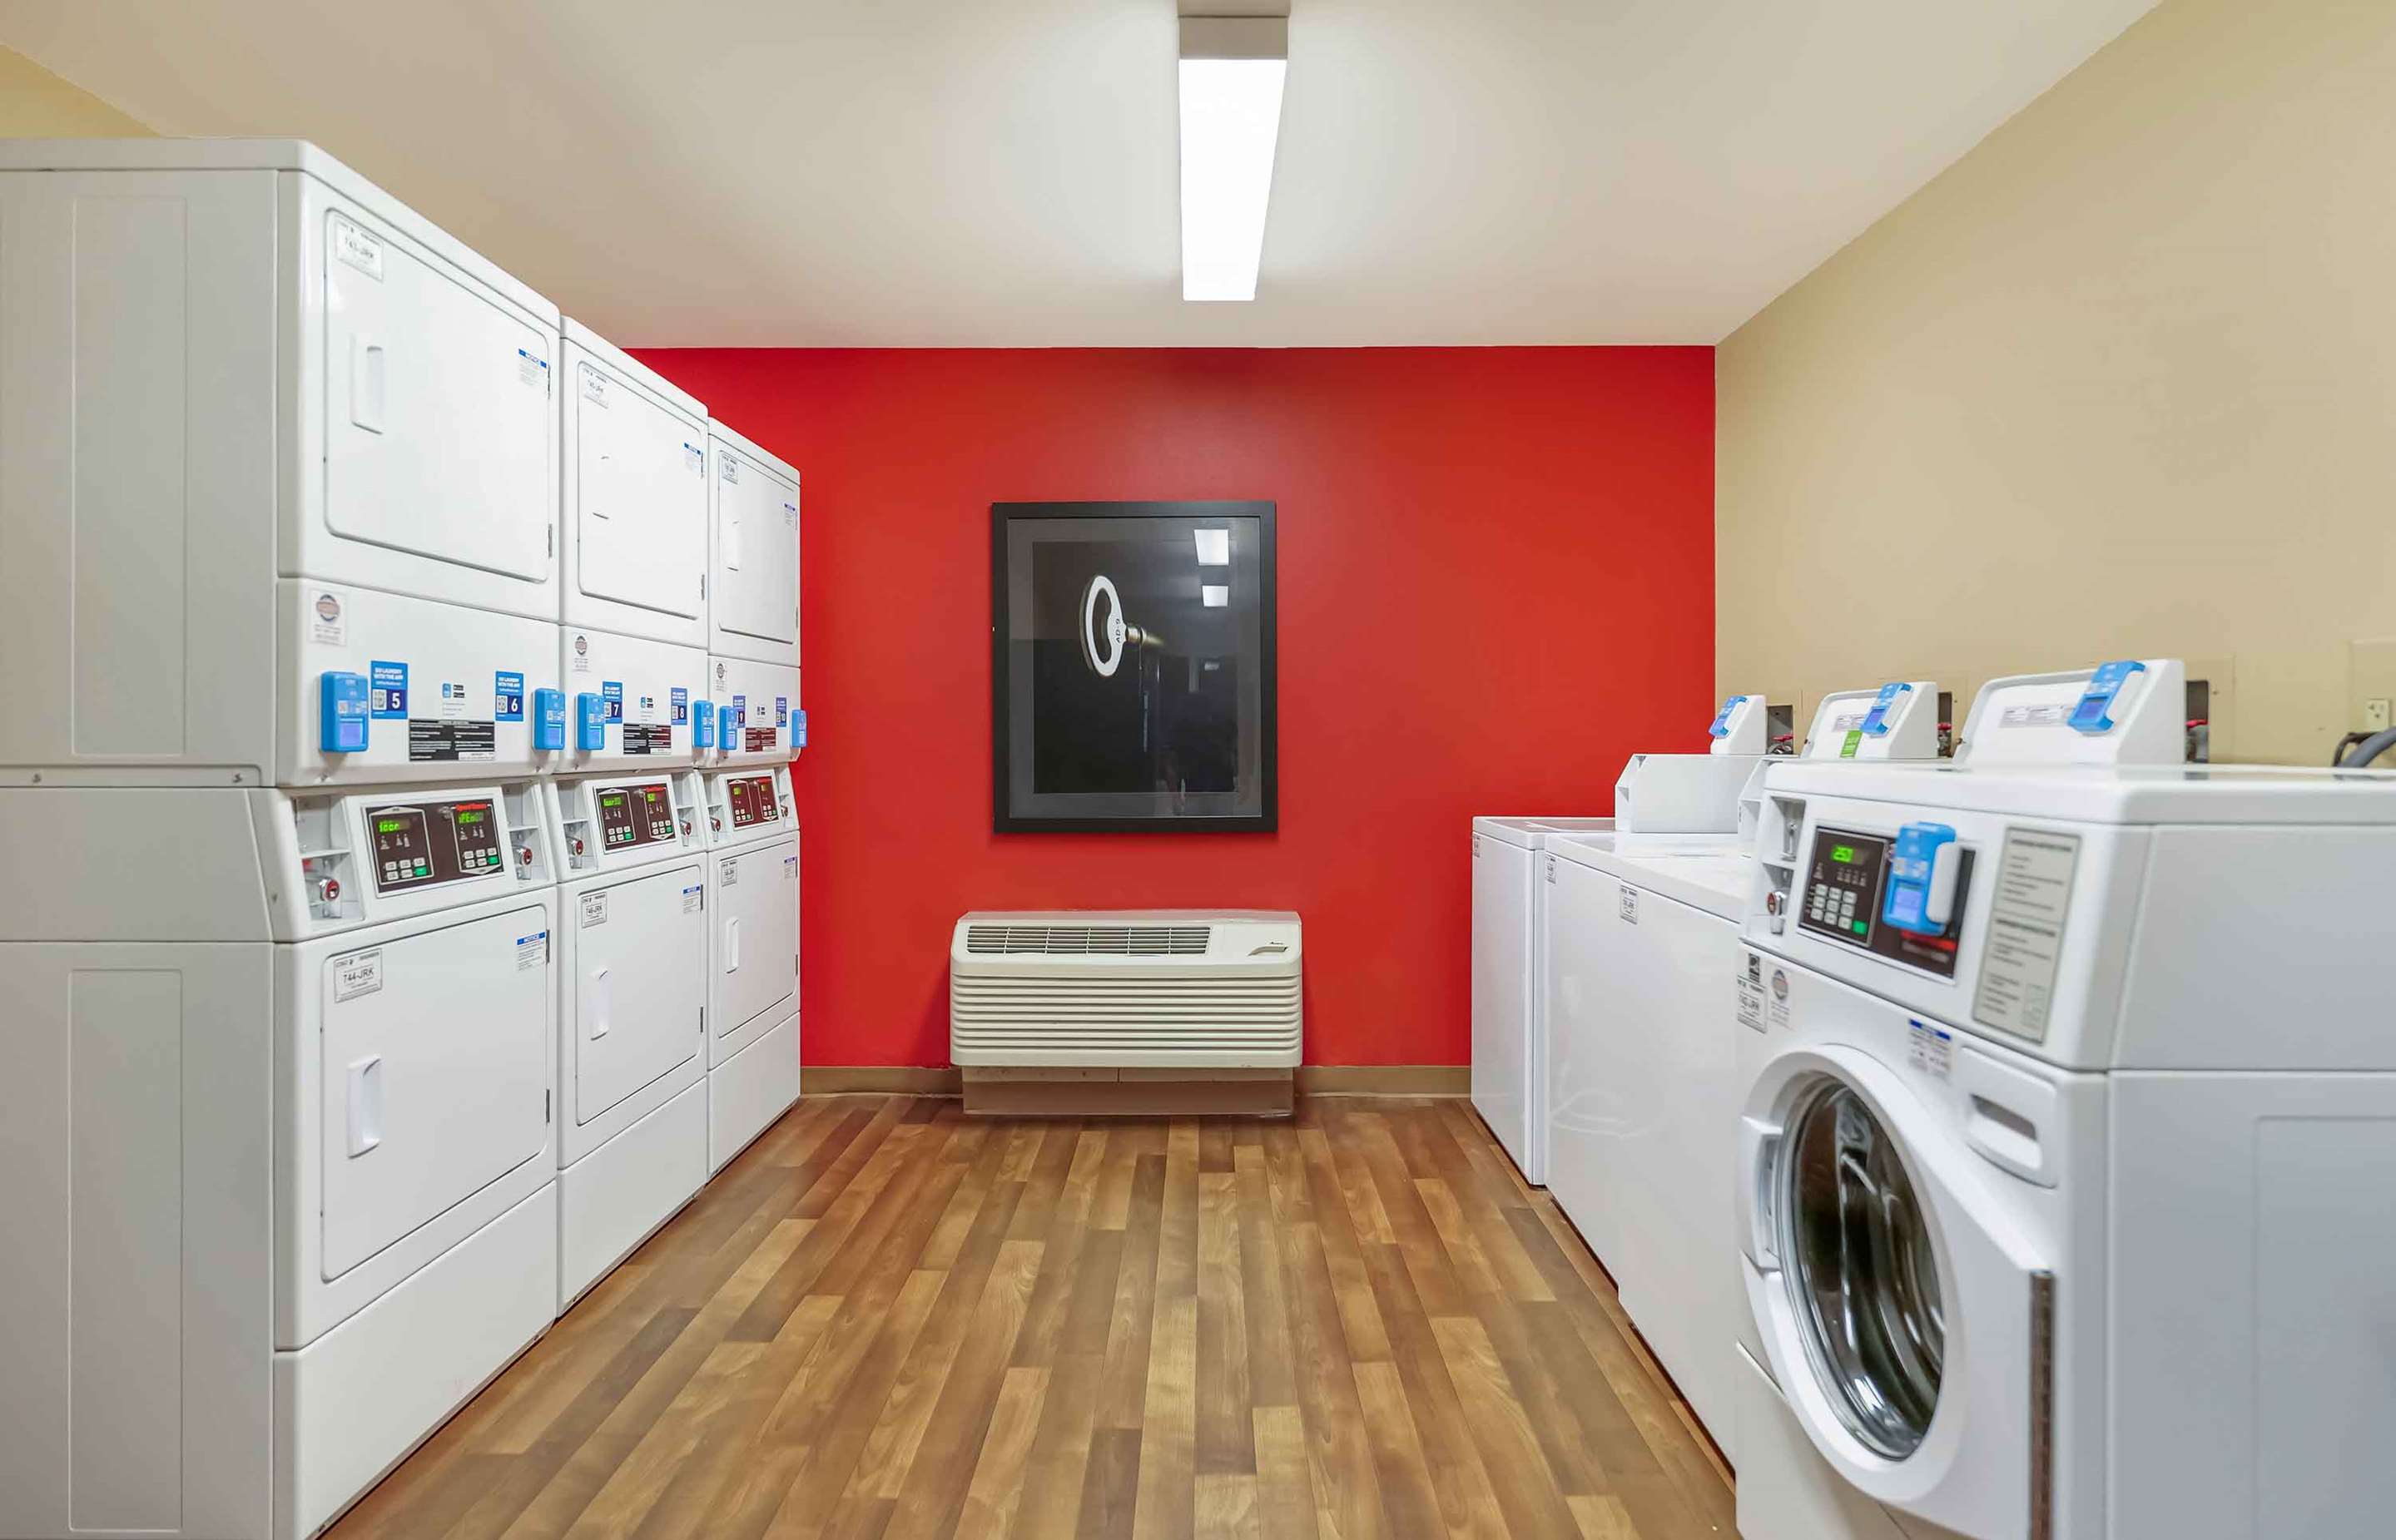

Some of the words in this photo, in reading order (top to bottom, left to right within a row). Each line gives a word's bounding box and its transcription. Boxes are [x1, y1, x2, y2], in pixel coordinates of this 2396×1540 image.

[392, 692, 400, 709] 5
[511, 698, 518, 712] 6
[613, 704, 619, 716] 7
[680, 707, 685, 719] 8
[739, 712, 744, 722] 9
[343, 968, 374, 984] 744-JRK
